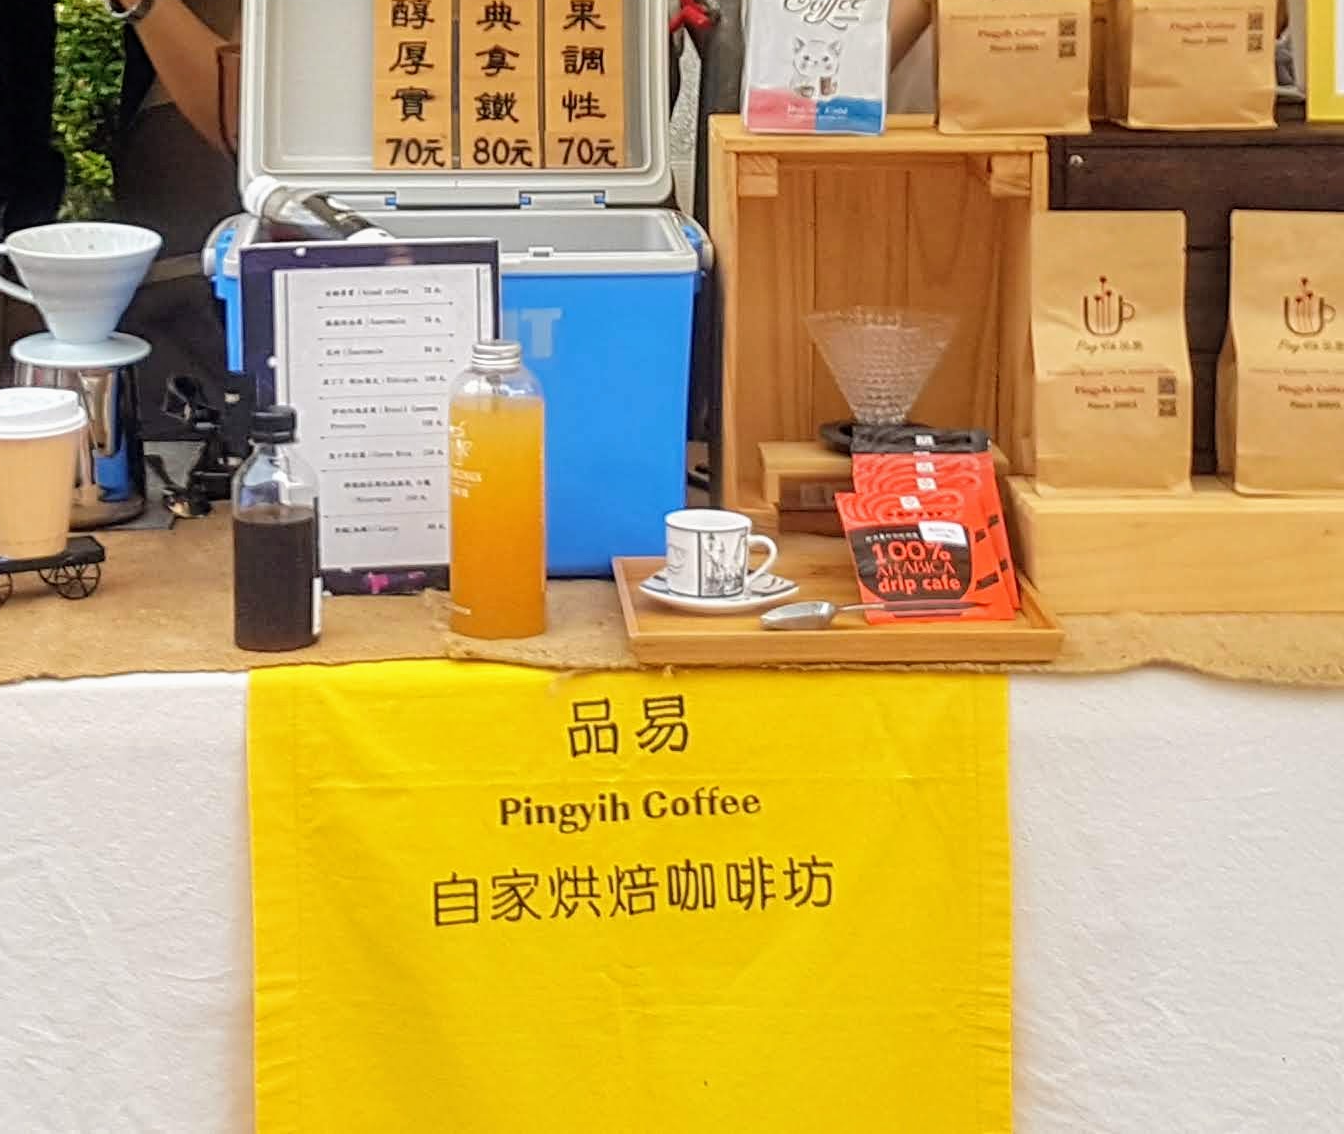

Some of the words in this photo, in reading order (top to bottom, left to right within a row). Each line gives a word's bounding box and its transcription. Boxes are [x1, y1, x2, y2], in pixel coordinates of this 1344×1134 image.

[386, 137, 446, 167] 70元
[472, 137, 533, 167] 80元
[558, 137, 619, 167] 70元
[871, 540, 952, 568] 100%
[877, 574, 918, 595] drip
[922, 573, 961, 592] cafe
[567, 694, 690, 757] 品易
[498, 793, 632, 835] Pingyih
[641, 785, 763, 822] Coffee
[431, 855, 836, 927] 自家烘焙咖啡坊
